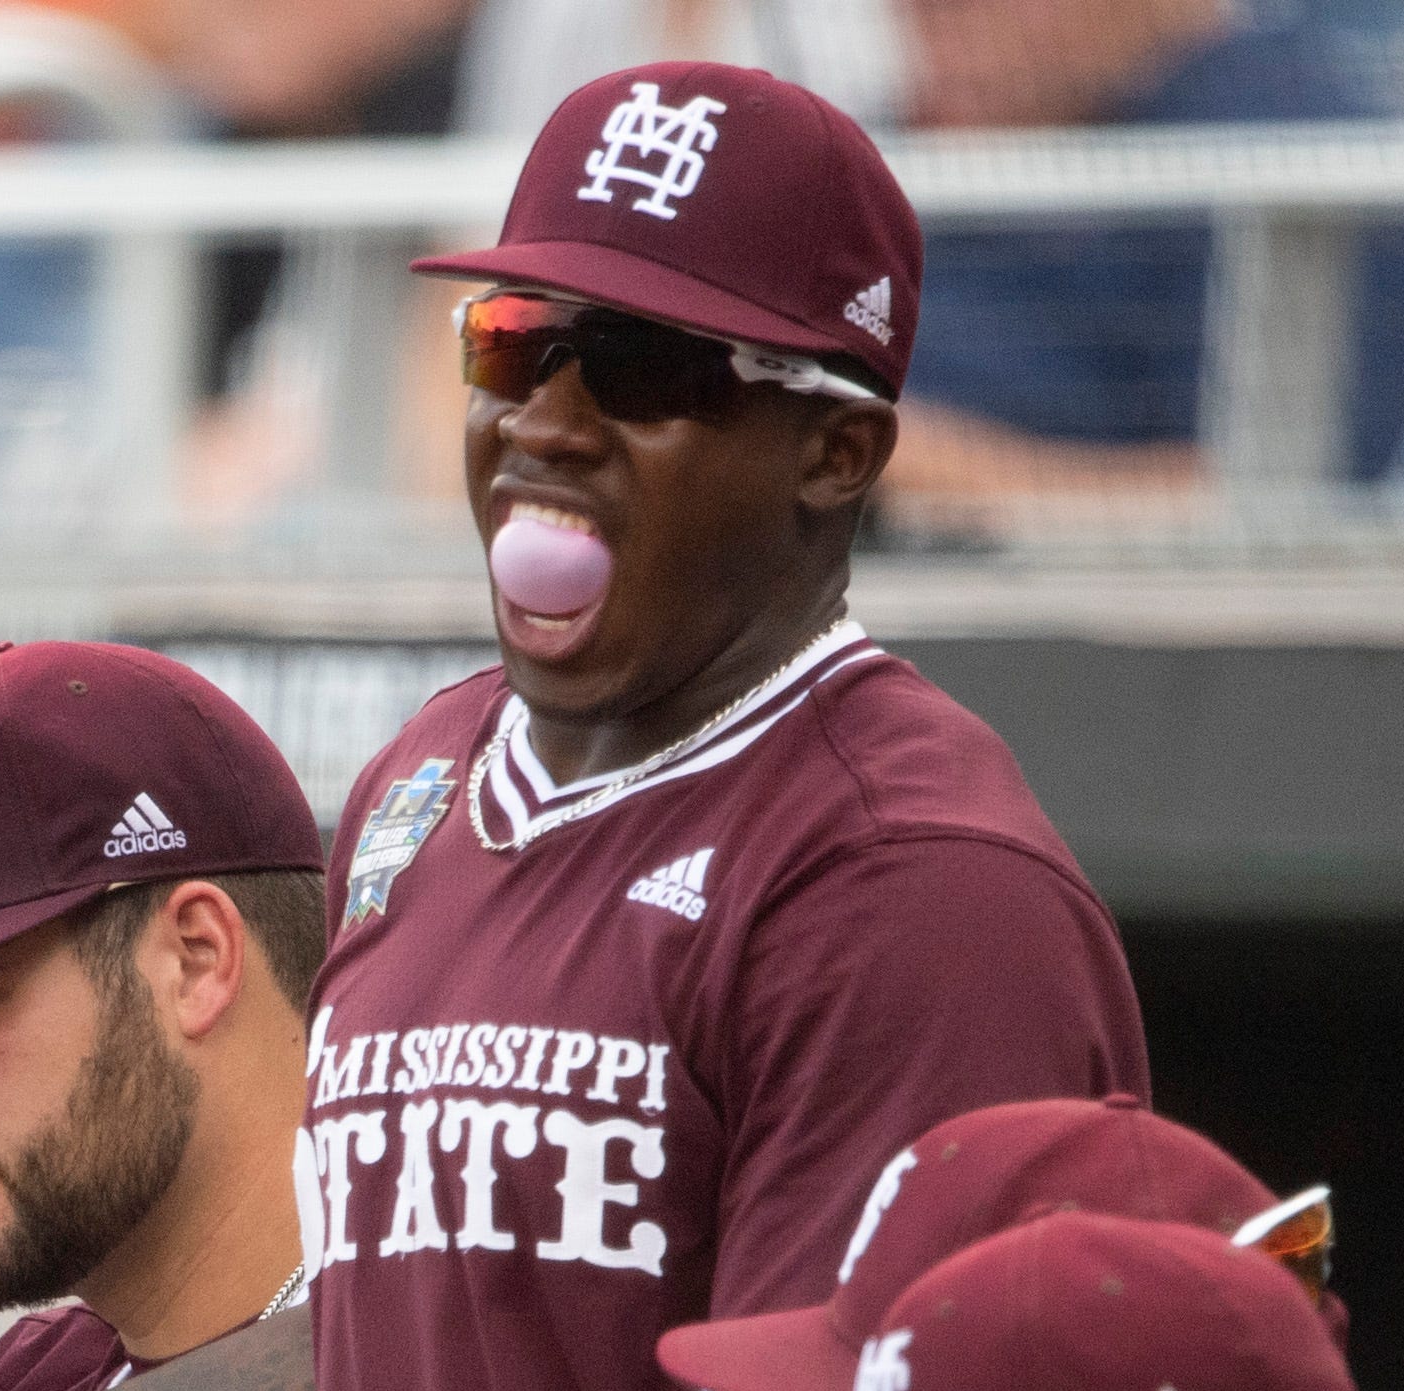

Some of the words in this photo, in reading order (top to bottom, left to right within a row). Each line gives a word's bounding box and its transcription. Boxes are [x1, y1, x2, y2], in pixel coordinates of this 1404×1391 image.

[103, 828, 187, 858] adidas
[626, 873, 707, 921] adidas
[313, 1023, 669, 1112] MISSISSIPPI
